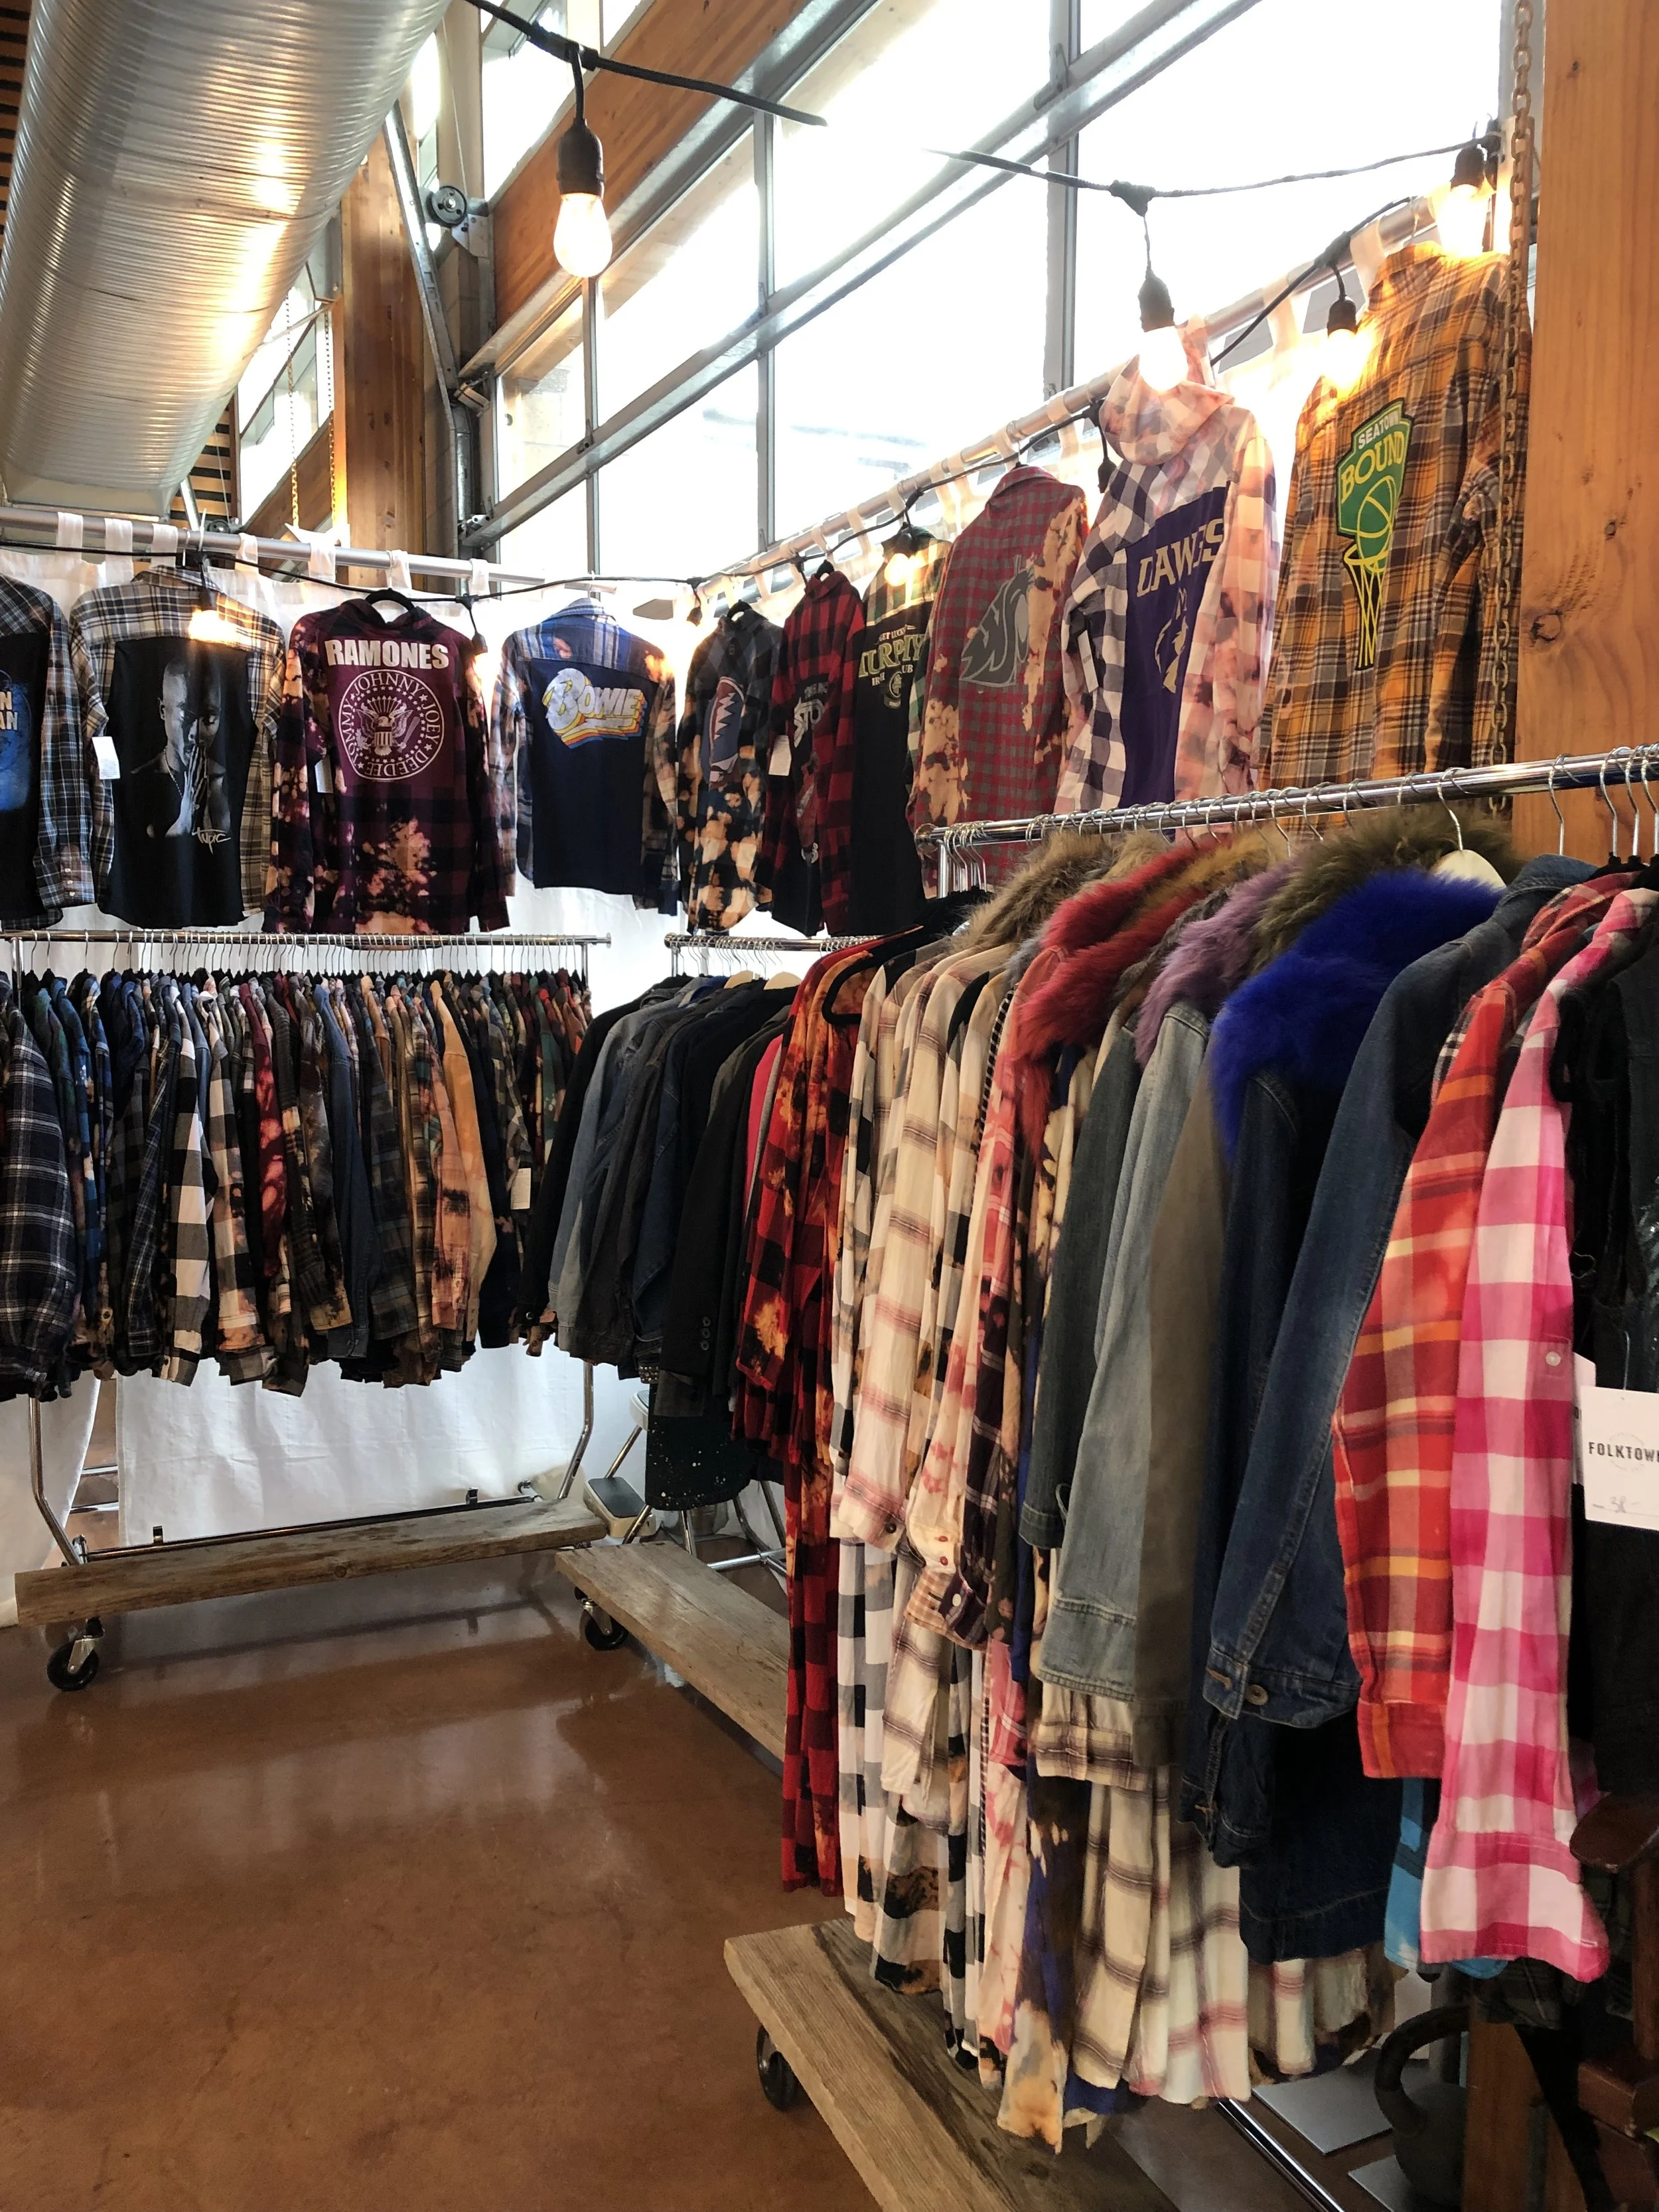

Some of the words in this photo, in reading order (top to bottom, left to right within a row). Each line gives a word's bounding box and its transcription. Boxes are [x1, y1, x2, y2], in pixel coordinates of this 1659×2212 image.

[1358, 409, 1401, 450] SEATOWN
[1341, 431, 1405, 504] BOUND
[325, 639, 449, 670] RAMONES
[901, 664, 914, 674] UB
[354, 672, 425, 696] JOHNNY
[541, 668, 647, 738] BOWIE
[342, 698, 360, 767] TOMMY
[421, 702, 441, 745] JOEY
